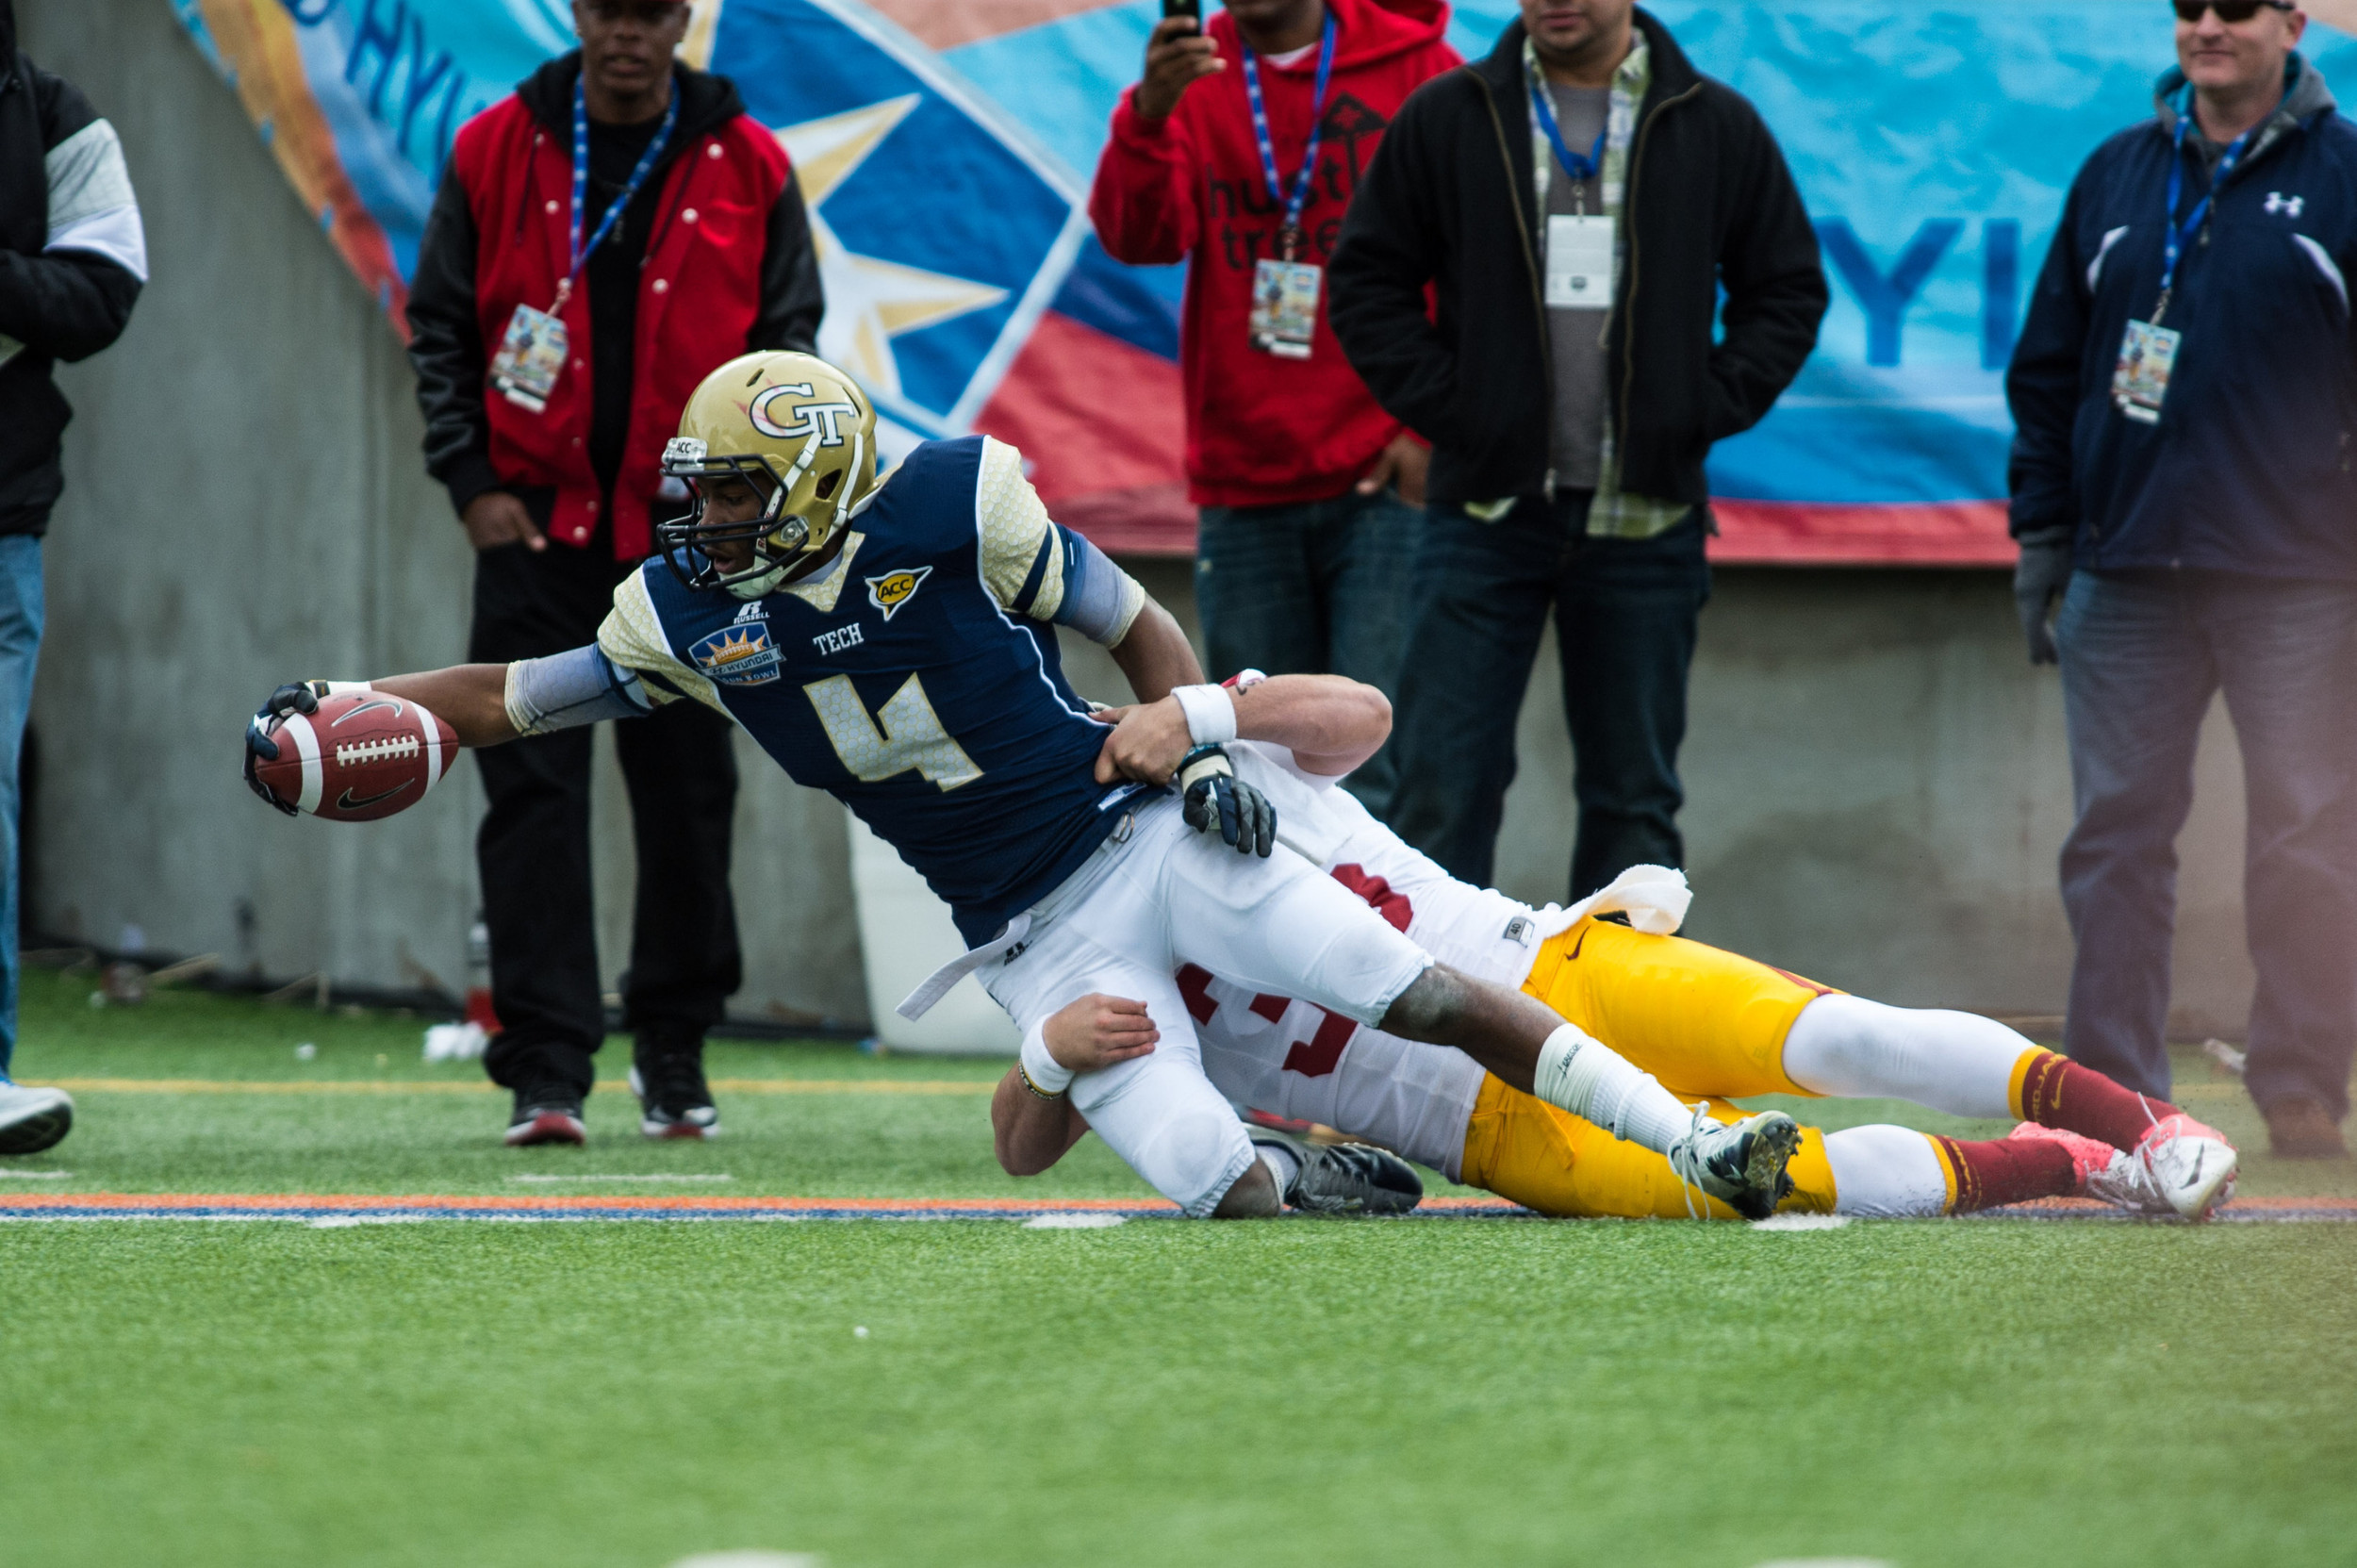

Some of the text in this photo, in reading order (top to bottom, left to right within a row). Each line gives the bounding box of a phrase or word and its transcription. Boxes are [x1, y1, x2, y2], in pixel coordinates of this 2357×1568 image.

[750, 383, 856, 447] GT
[675, 441, 692, 454] ACC
[881, 578, 911, 600] ACC
[733, 611, 769, 623] RUSSELL
[813, 622, 865, 655] TECH
[727, 652, 772, 671] HYUNDAI
[745, 669, 777, 681] BOWL
[803, 672, 985, 792] 4
[1509, 923, 1521, 934] 40
